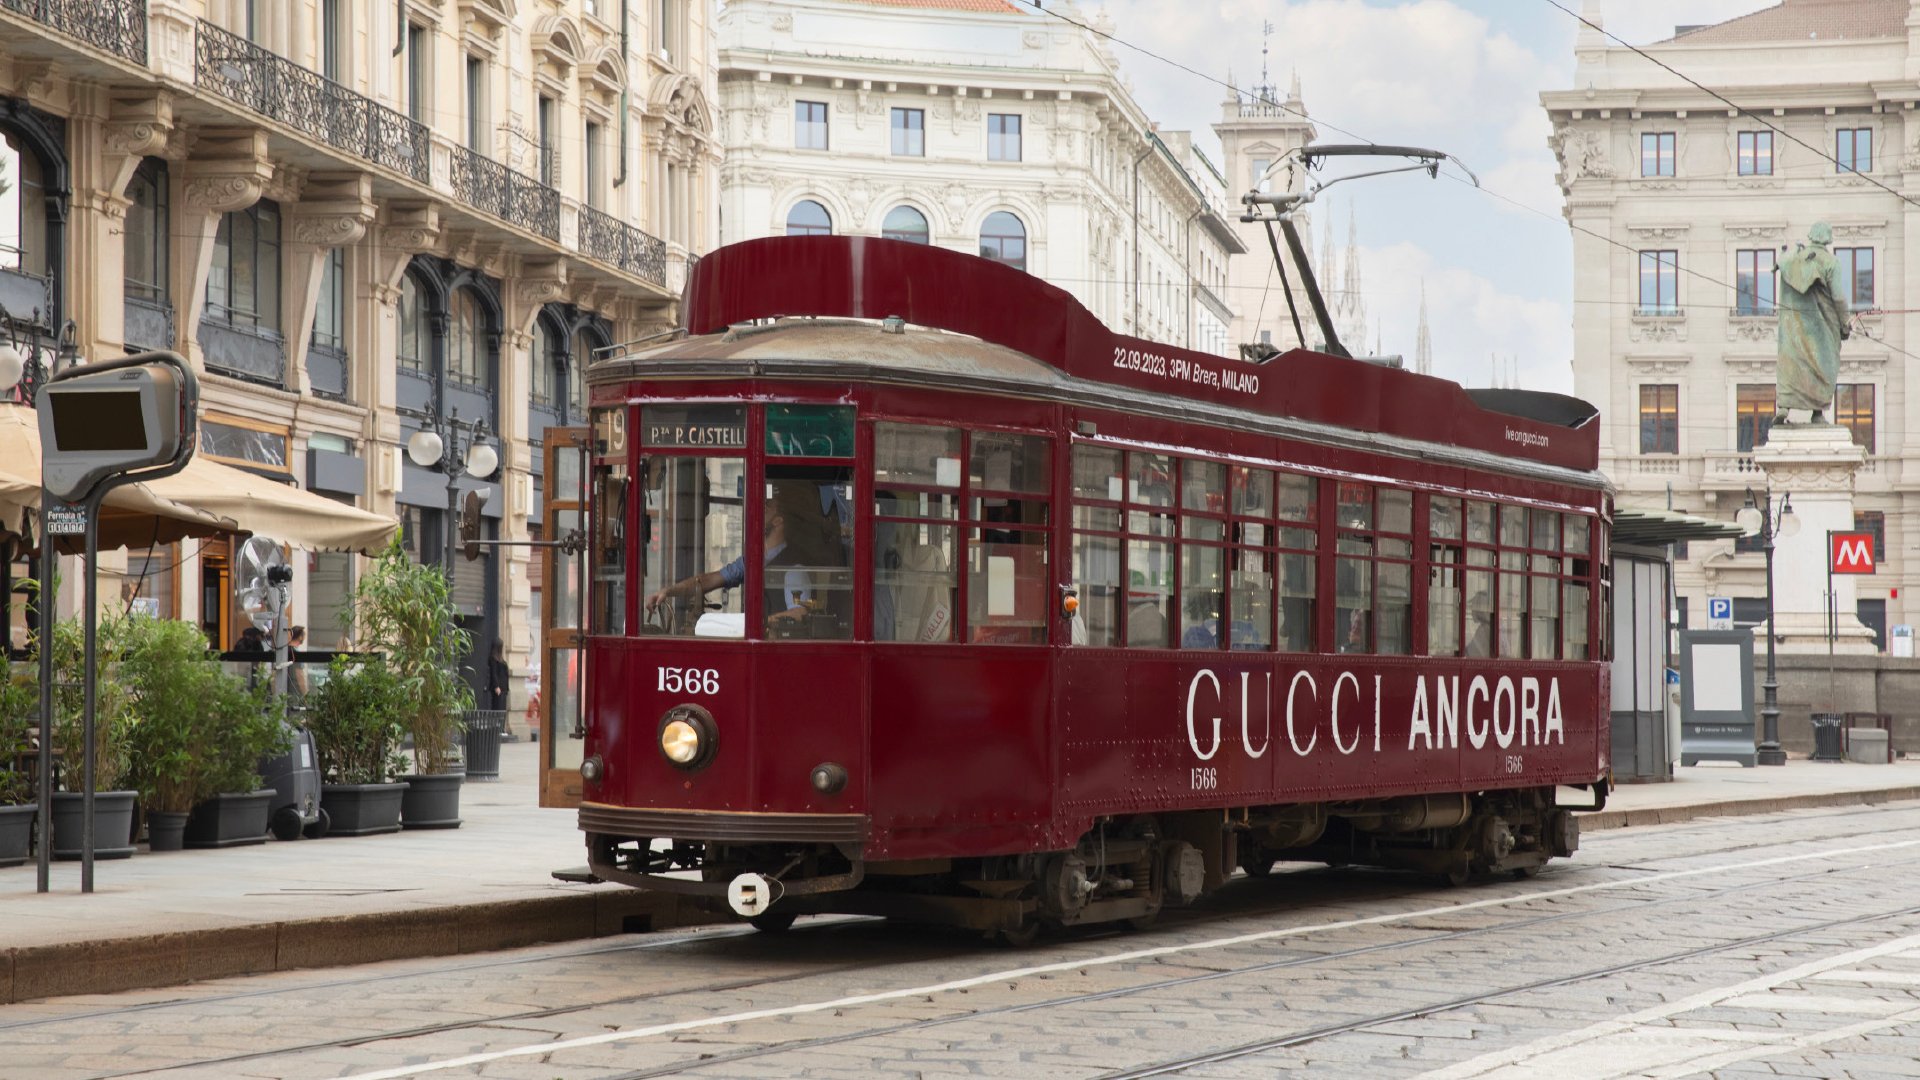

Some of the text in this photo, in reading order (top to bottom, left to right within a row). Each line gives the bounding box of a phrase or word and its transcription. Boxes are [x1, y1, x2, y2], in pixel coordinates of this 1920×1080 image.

[1113, 347, 1259, 394] 22.09.2023, 3PM Brera, MILANO
[608, 408, 625, 451] 19
[48, 511, 76, 520] Fermata
[1836, 540, 1872, 566] M
[1713, 600, 1727, 617] P
[657, 666, 720, 695] 1566
[1186, 668, 1564, 760] GUCCI ANCORA
[1505, 755, 1523, 774] 1566
[1191, 767, 1217, 790] 1566
